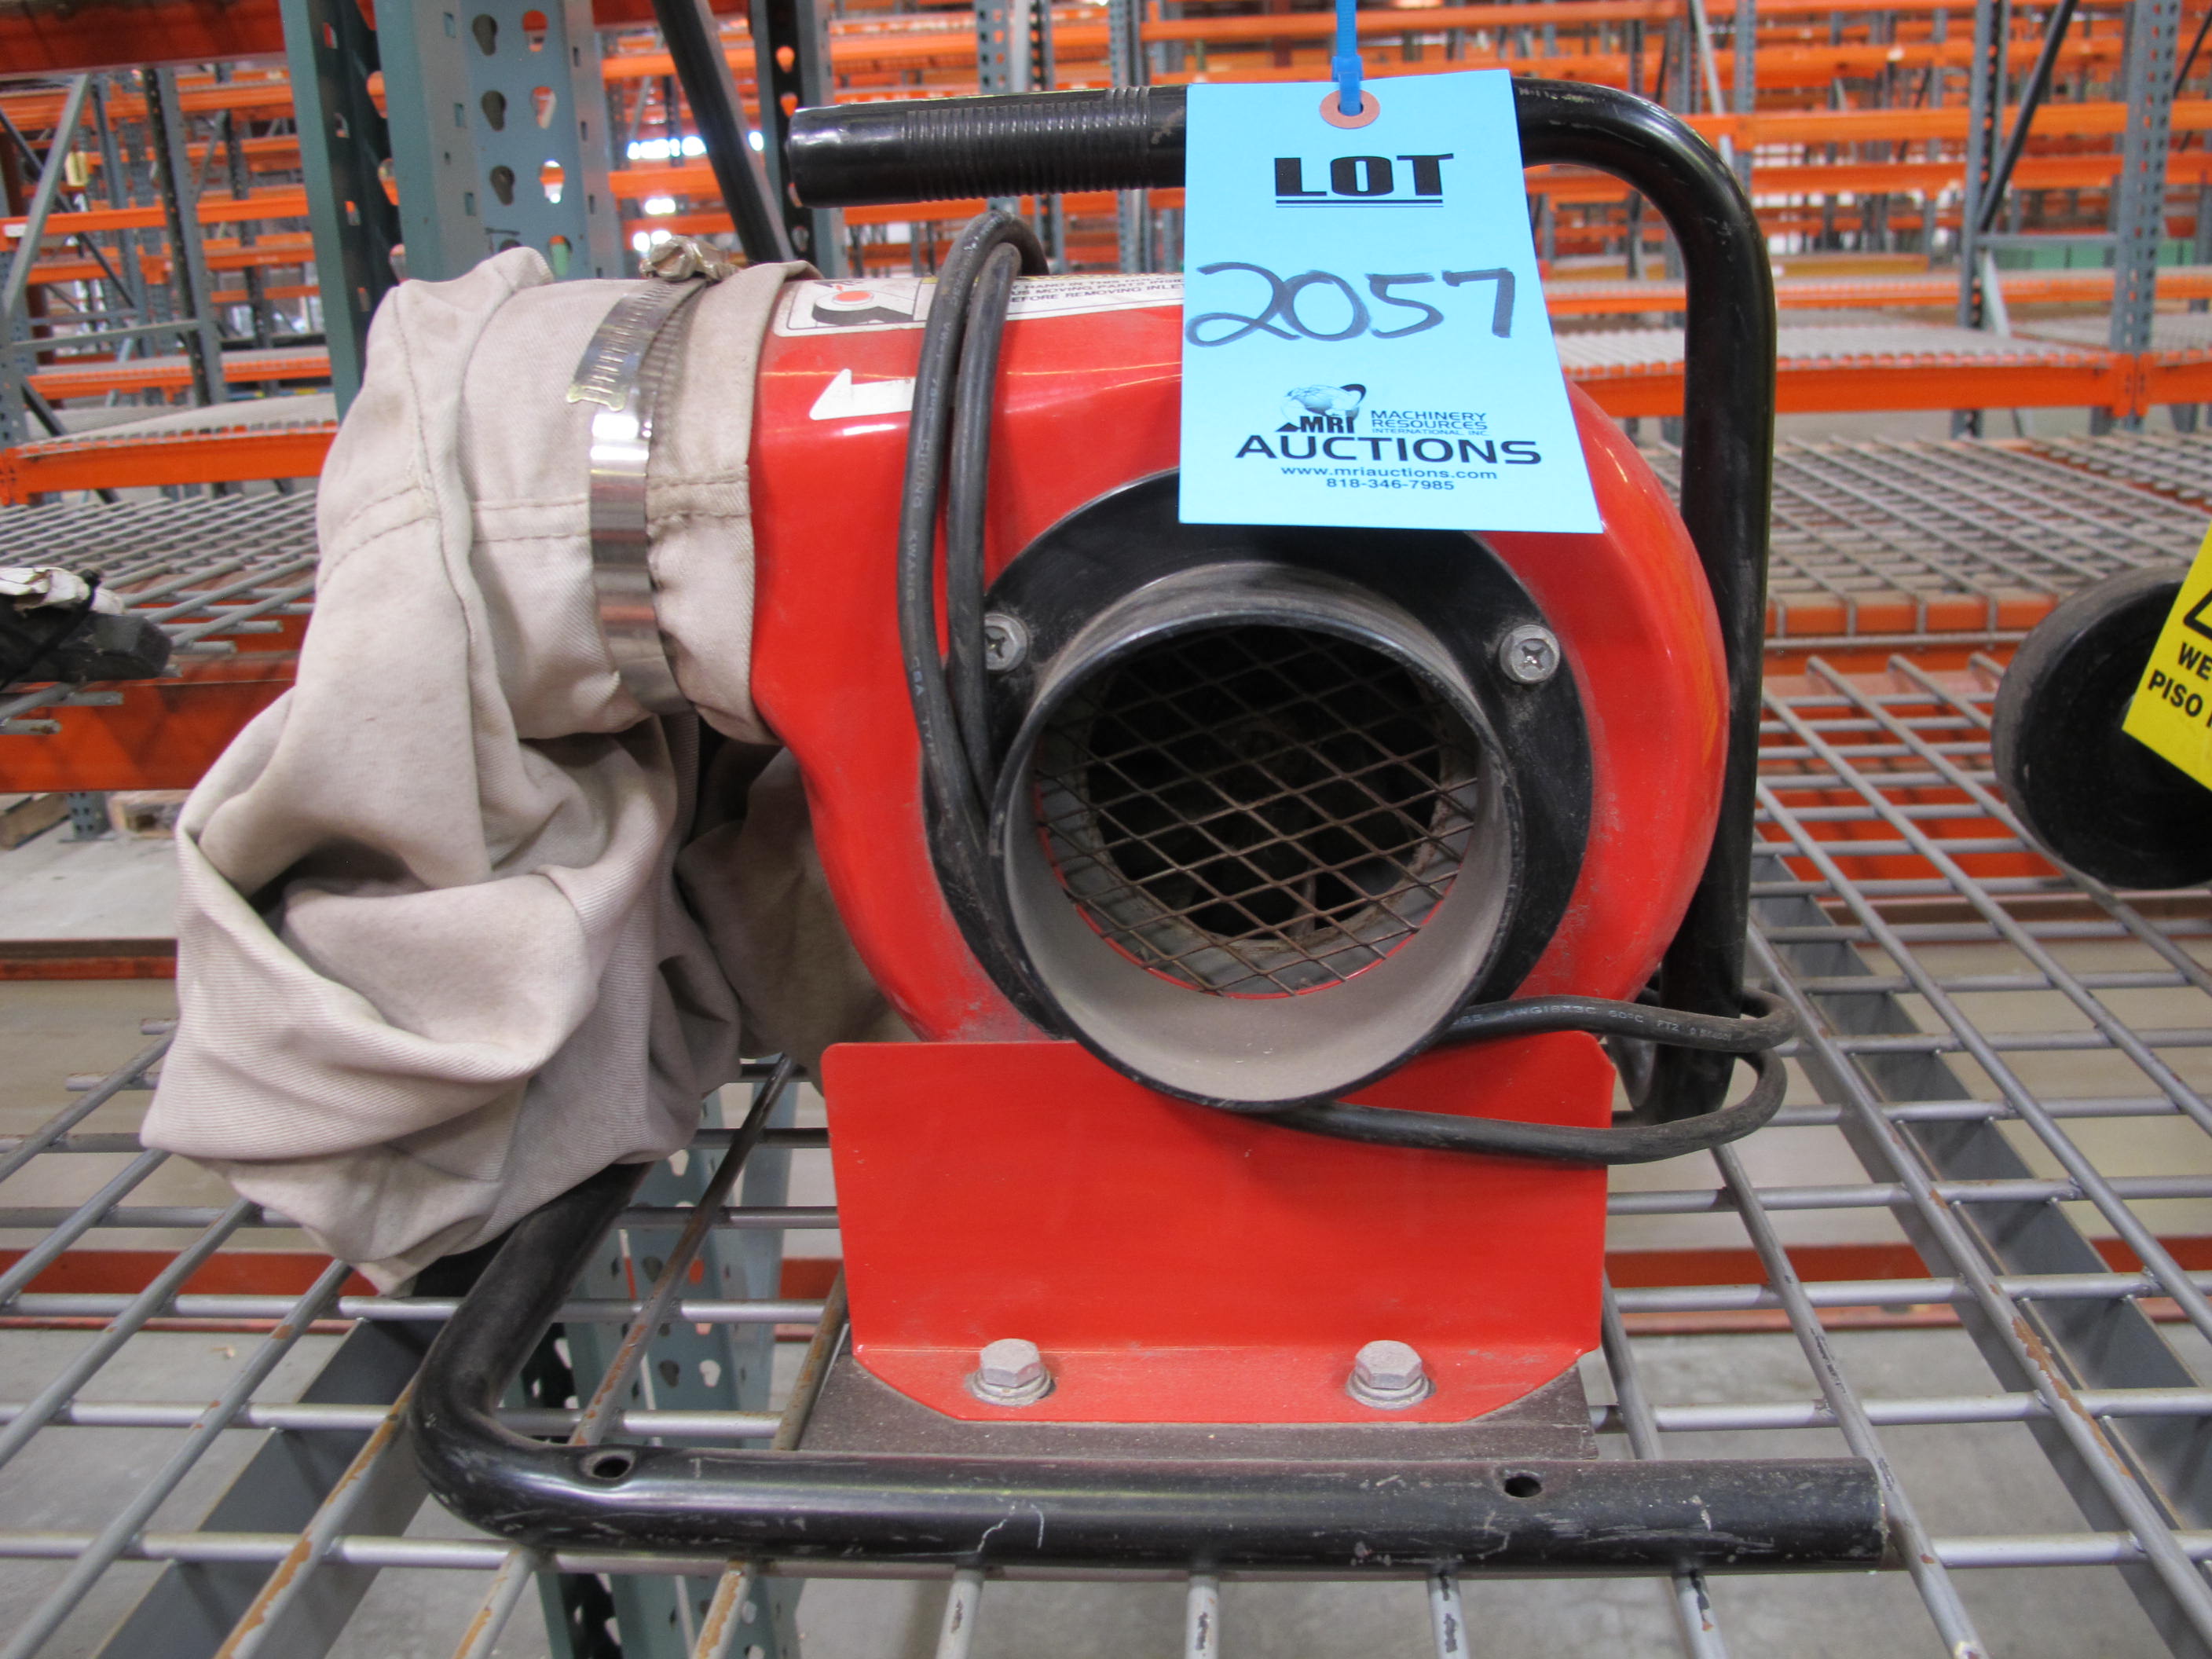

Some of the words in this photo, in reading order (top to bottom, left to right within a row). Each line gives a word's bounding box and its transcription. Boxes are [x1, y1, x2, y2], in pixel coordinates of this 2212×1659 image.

[1274, 153, 1454, 196] LOT
[1009, 294, 1059, 302] EFORE
[1185, 262, 1516, 347] 2057
[1371, 410, 1487, 422] MACHINERY
[1298, 416, 1355, 434] MRI
[1372, 419, 1489, 430] RESOURCES
[1372, 428, 1464, 437] INTERNATIONAL
[1235, 435, 1542, 466] AUCTIONS
[1280, 466, 1498, 480] www.mriauctions.com
[1326, 478, 1455, 491] 818-346-7985
[2148, 669, 2203, 717] PISO
